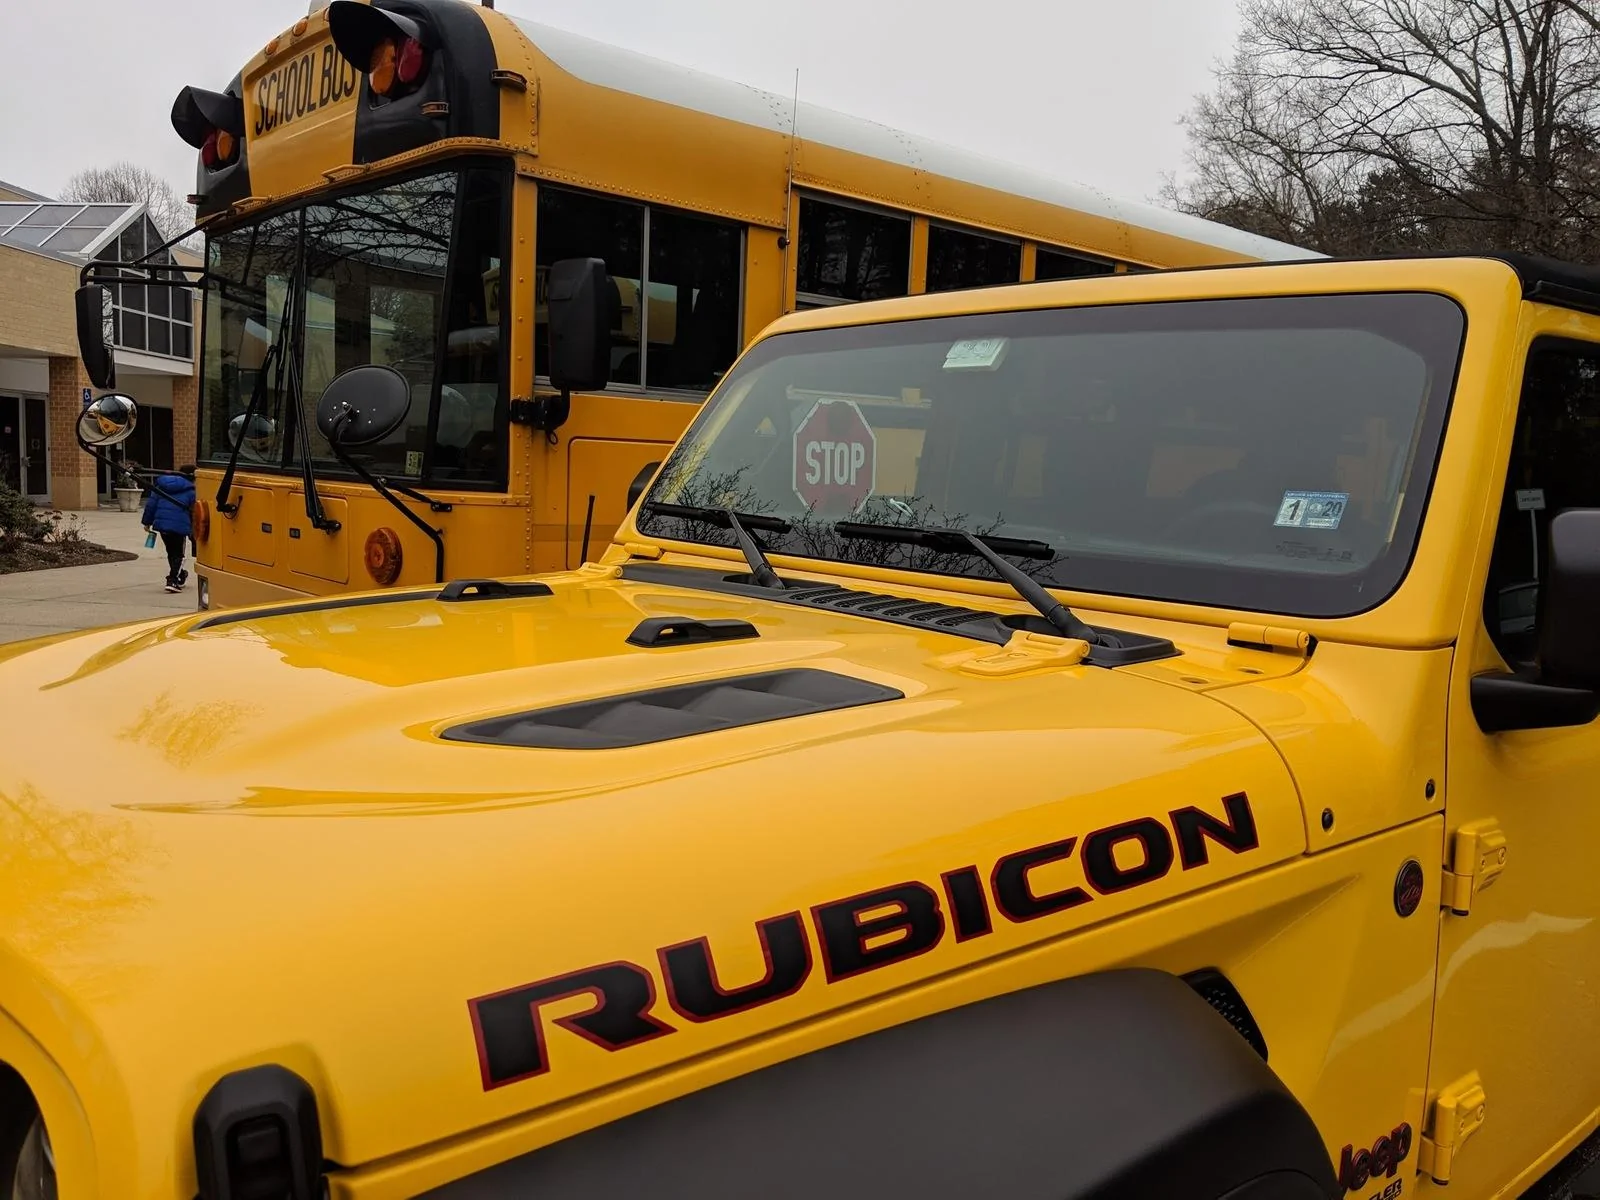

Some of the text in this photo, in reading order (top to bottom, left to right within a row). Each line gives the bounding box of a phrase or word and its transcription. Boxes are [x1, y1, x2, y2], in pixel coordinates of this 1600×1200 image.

[255, 52, 317, 136] SCHOOL
[805, 441, 865, 486] STOP
[1288, 499, 1343, 521] 1 20
[467, 790, 1260, 1091] RUBICON
[1339, 1122, 1412, 1194] Jeep
